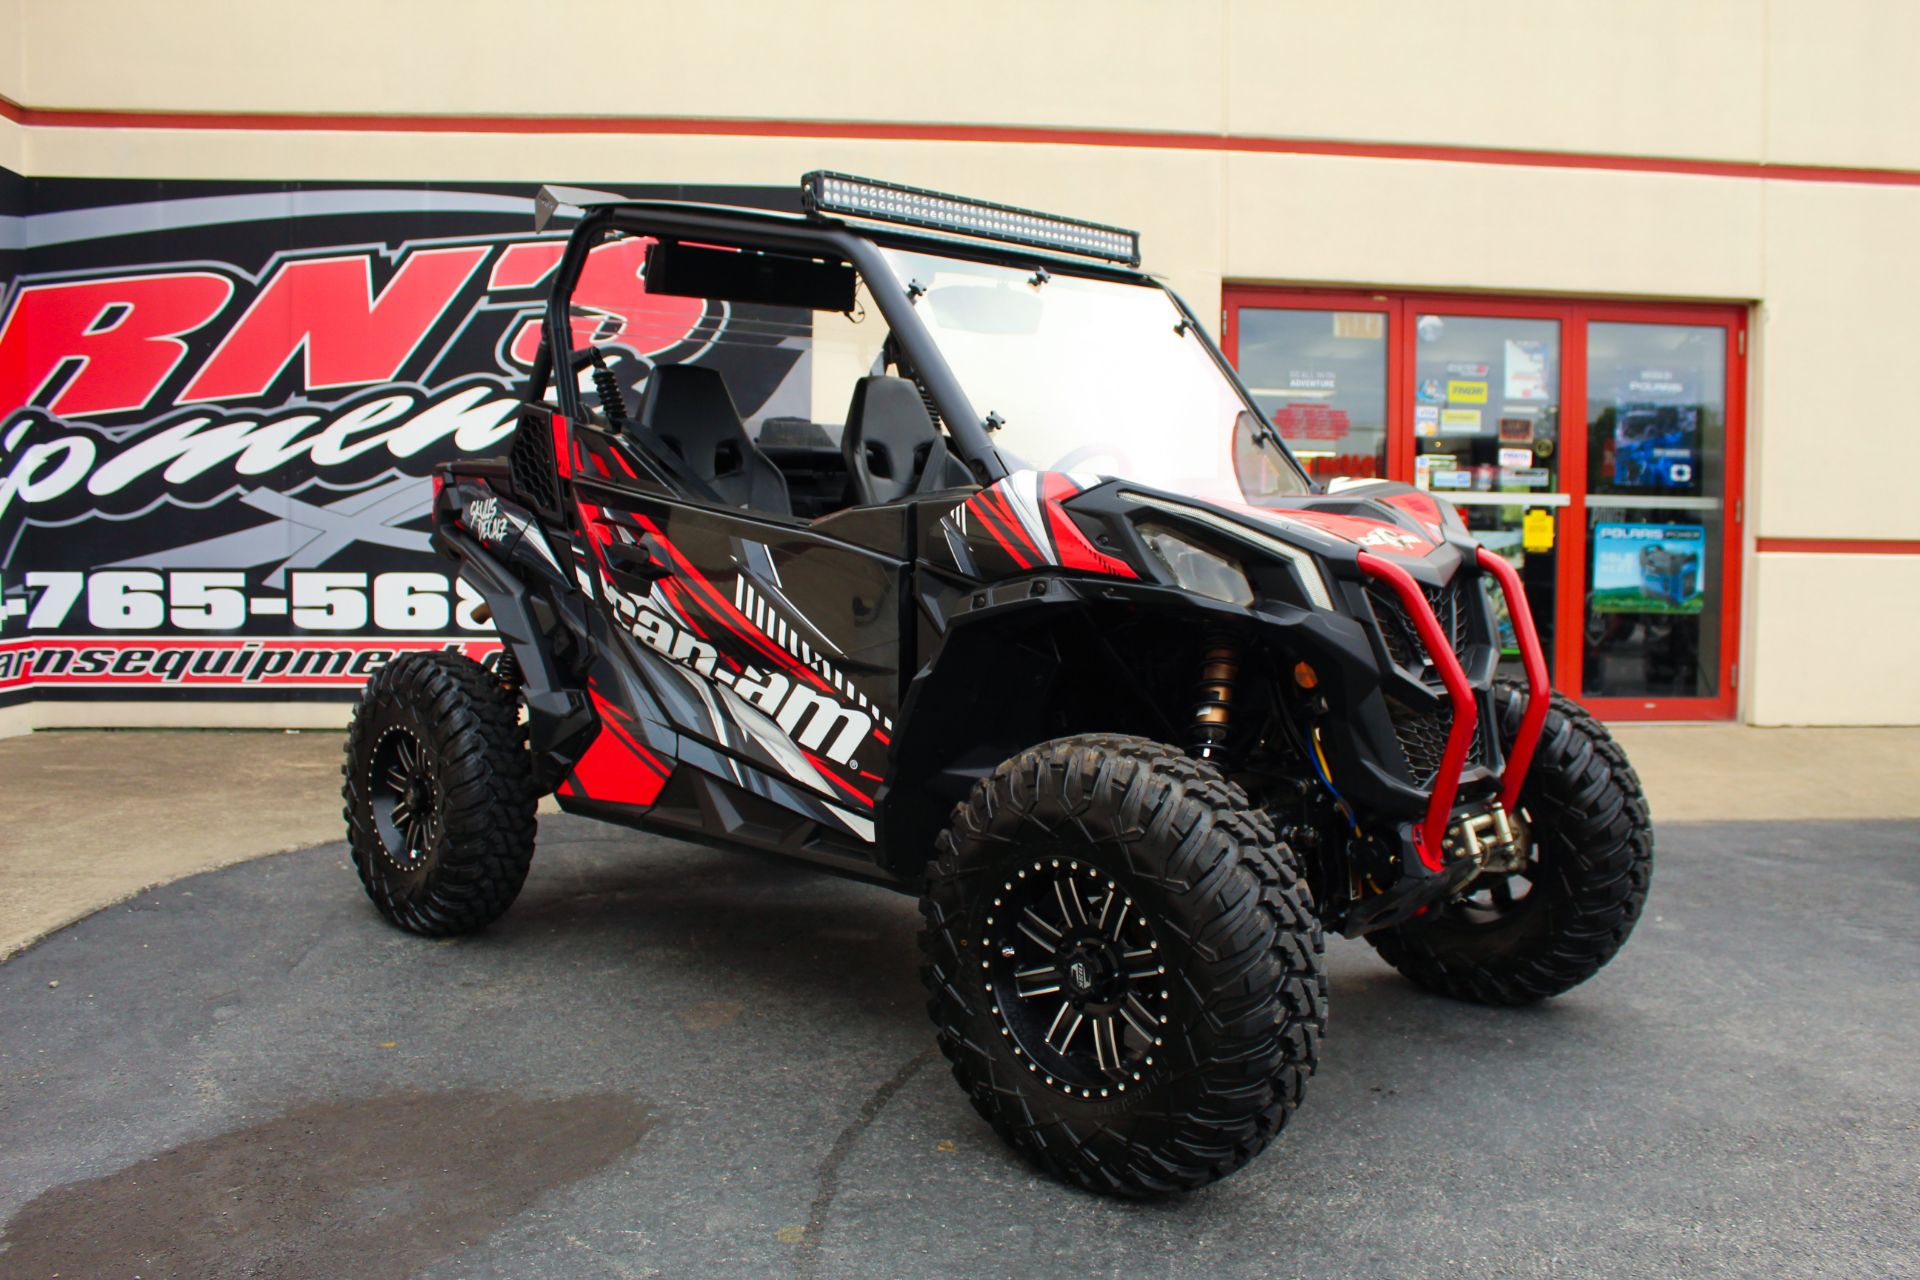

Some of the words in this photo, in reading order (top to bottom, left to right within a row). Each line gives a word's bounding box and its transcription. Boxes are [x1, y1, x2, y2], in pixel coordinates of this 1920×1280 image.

[1289, 380, 1336, 389] ADVENTURE
[1601, 528, 1663, 540] POLARIS
[0, 572, 498, 630] -765-56
[607, 583, 873, 765] can-am
